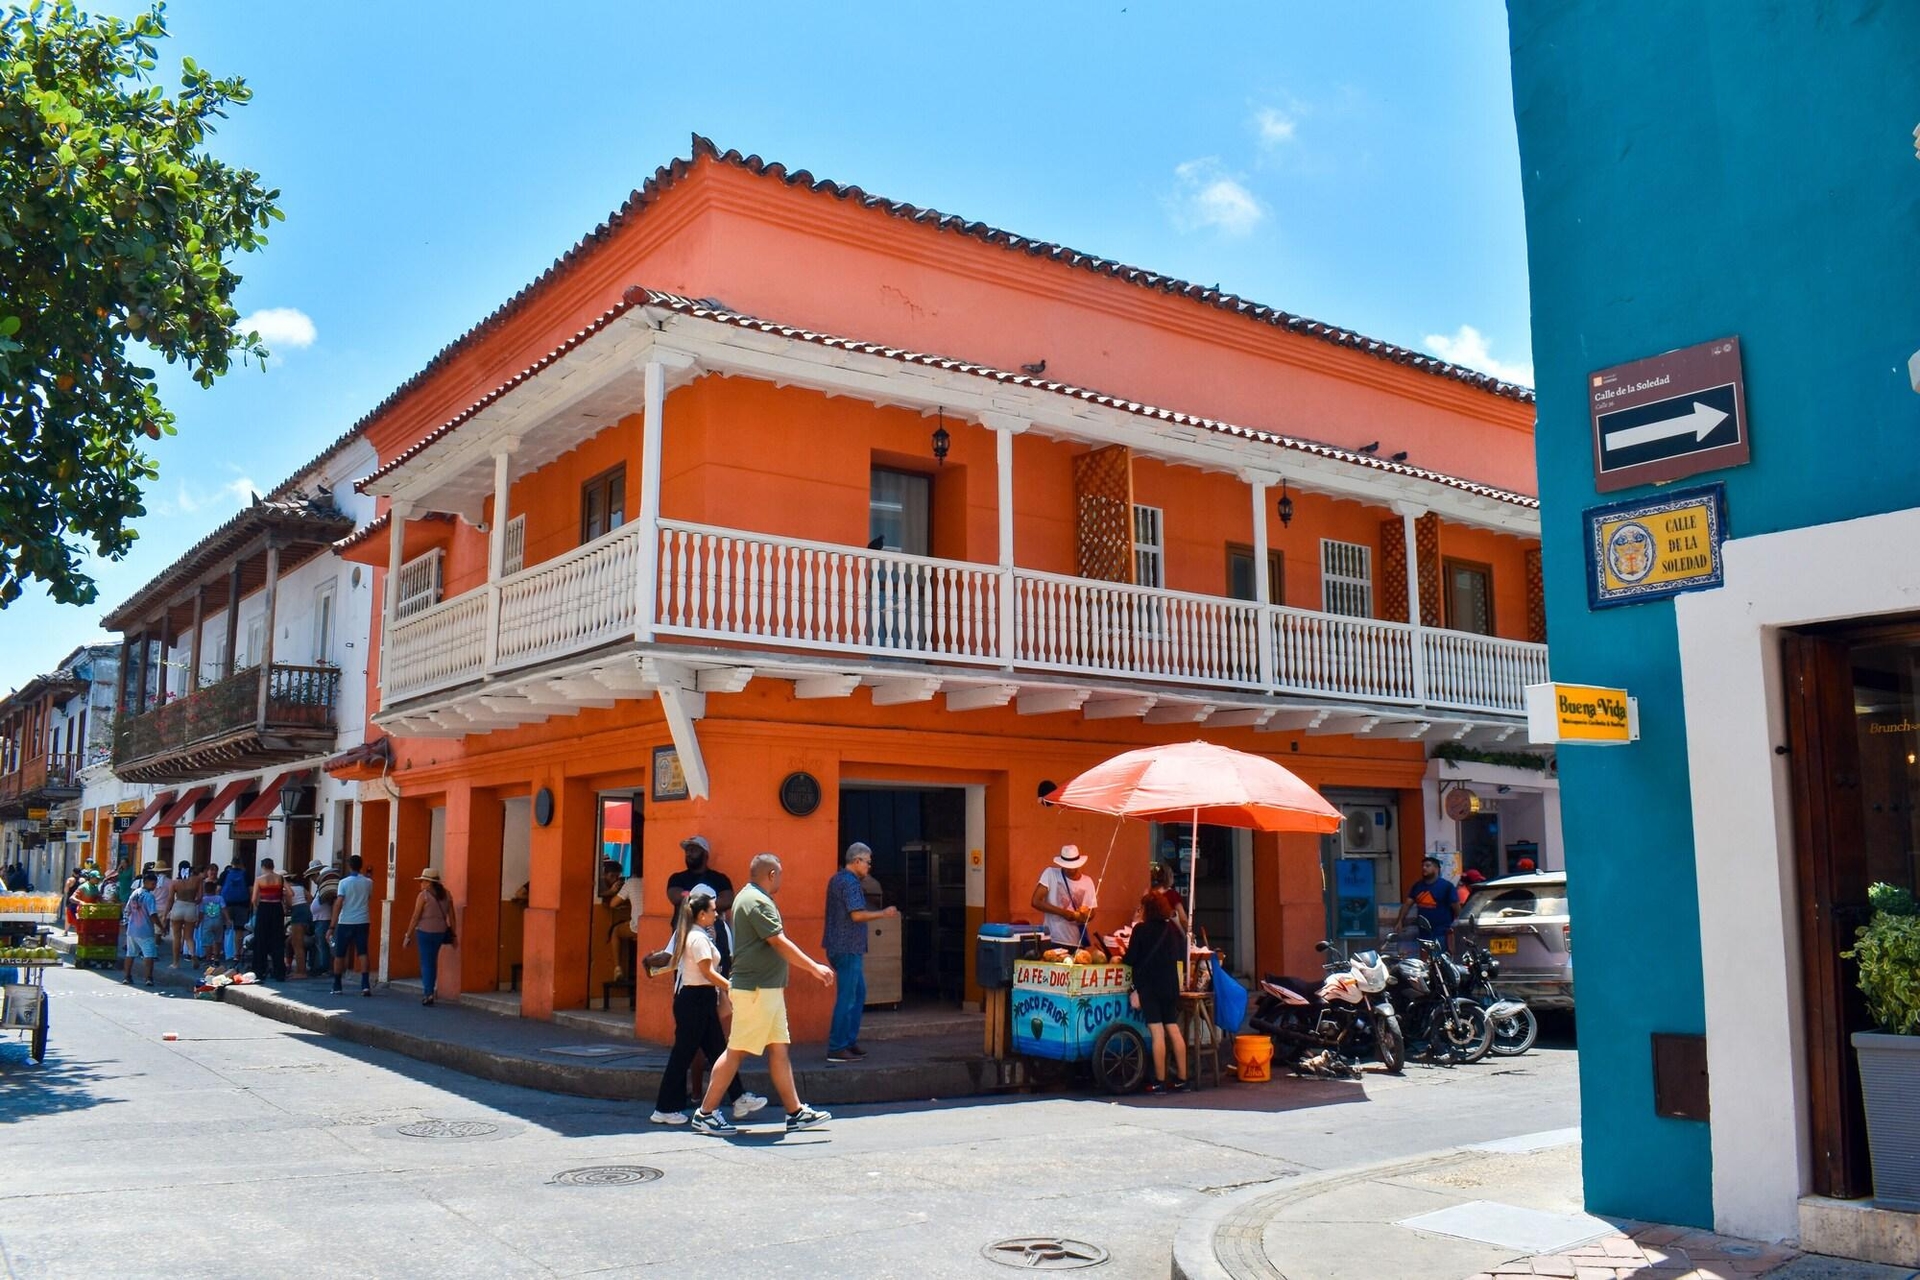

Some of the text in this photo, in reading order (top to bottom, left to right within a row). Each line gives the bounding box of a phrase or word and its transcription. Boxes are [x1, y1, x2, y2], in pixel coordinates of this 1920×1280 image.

[1594, 374, 1670, 401] Calle de la Soledad
[1665, 515, 1697, 533] CALLE
[1669, 535, 1697, 553] DE LA
[1662, 554, 1708, 574] SOLEDAD
[1559, 695, 1627, 721] Buena Vida
[1870, 719, 1911, 734] Brunch
[1017, 967, 1030, 983] LA
[1032, 967, 1043, 984] FE
[1049, 970, 1070, 987] DIOS
[1081, 969, 1099, 987] LA
[1103, 967, 1123, 987] FE
[1018, 996, 1062, 1023] COCO FRIO
[1084, 1000, 1121, 1034] COCO
